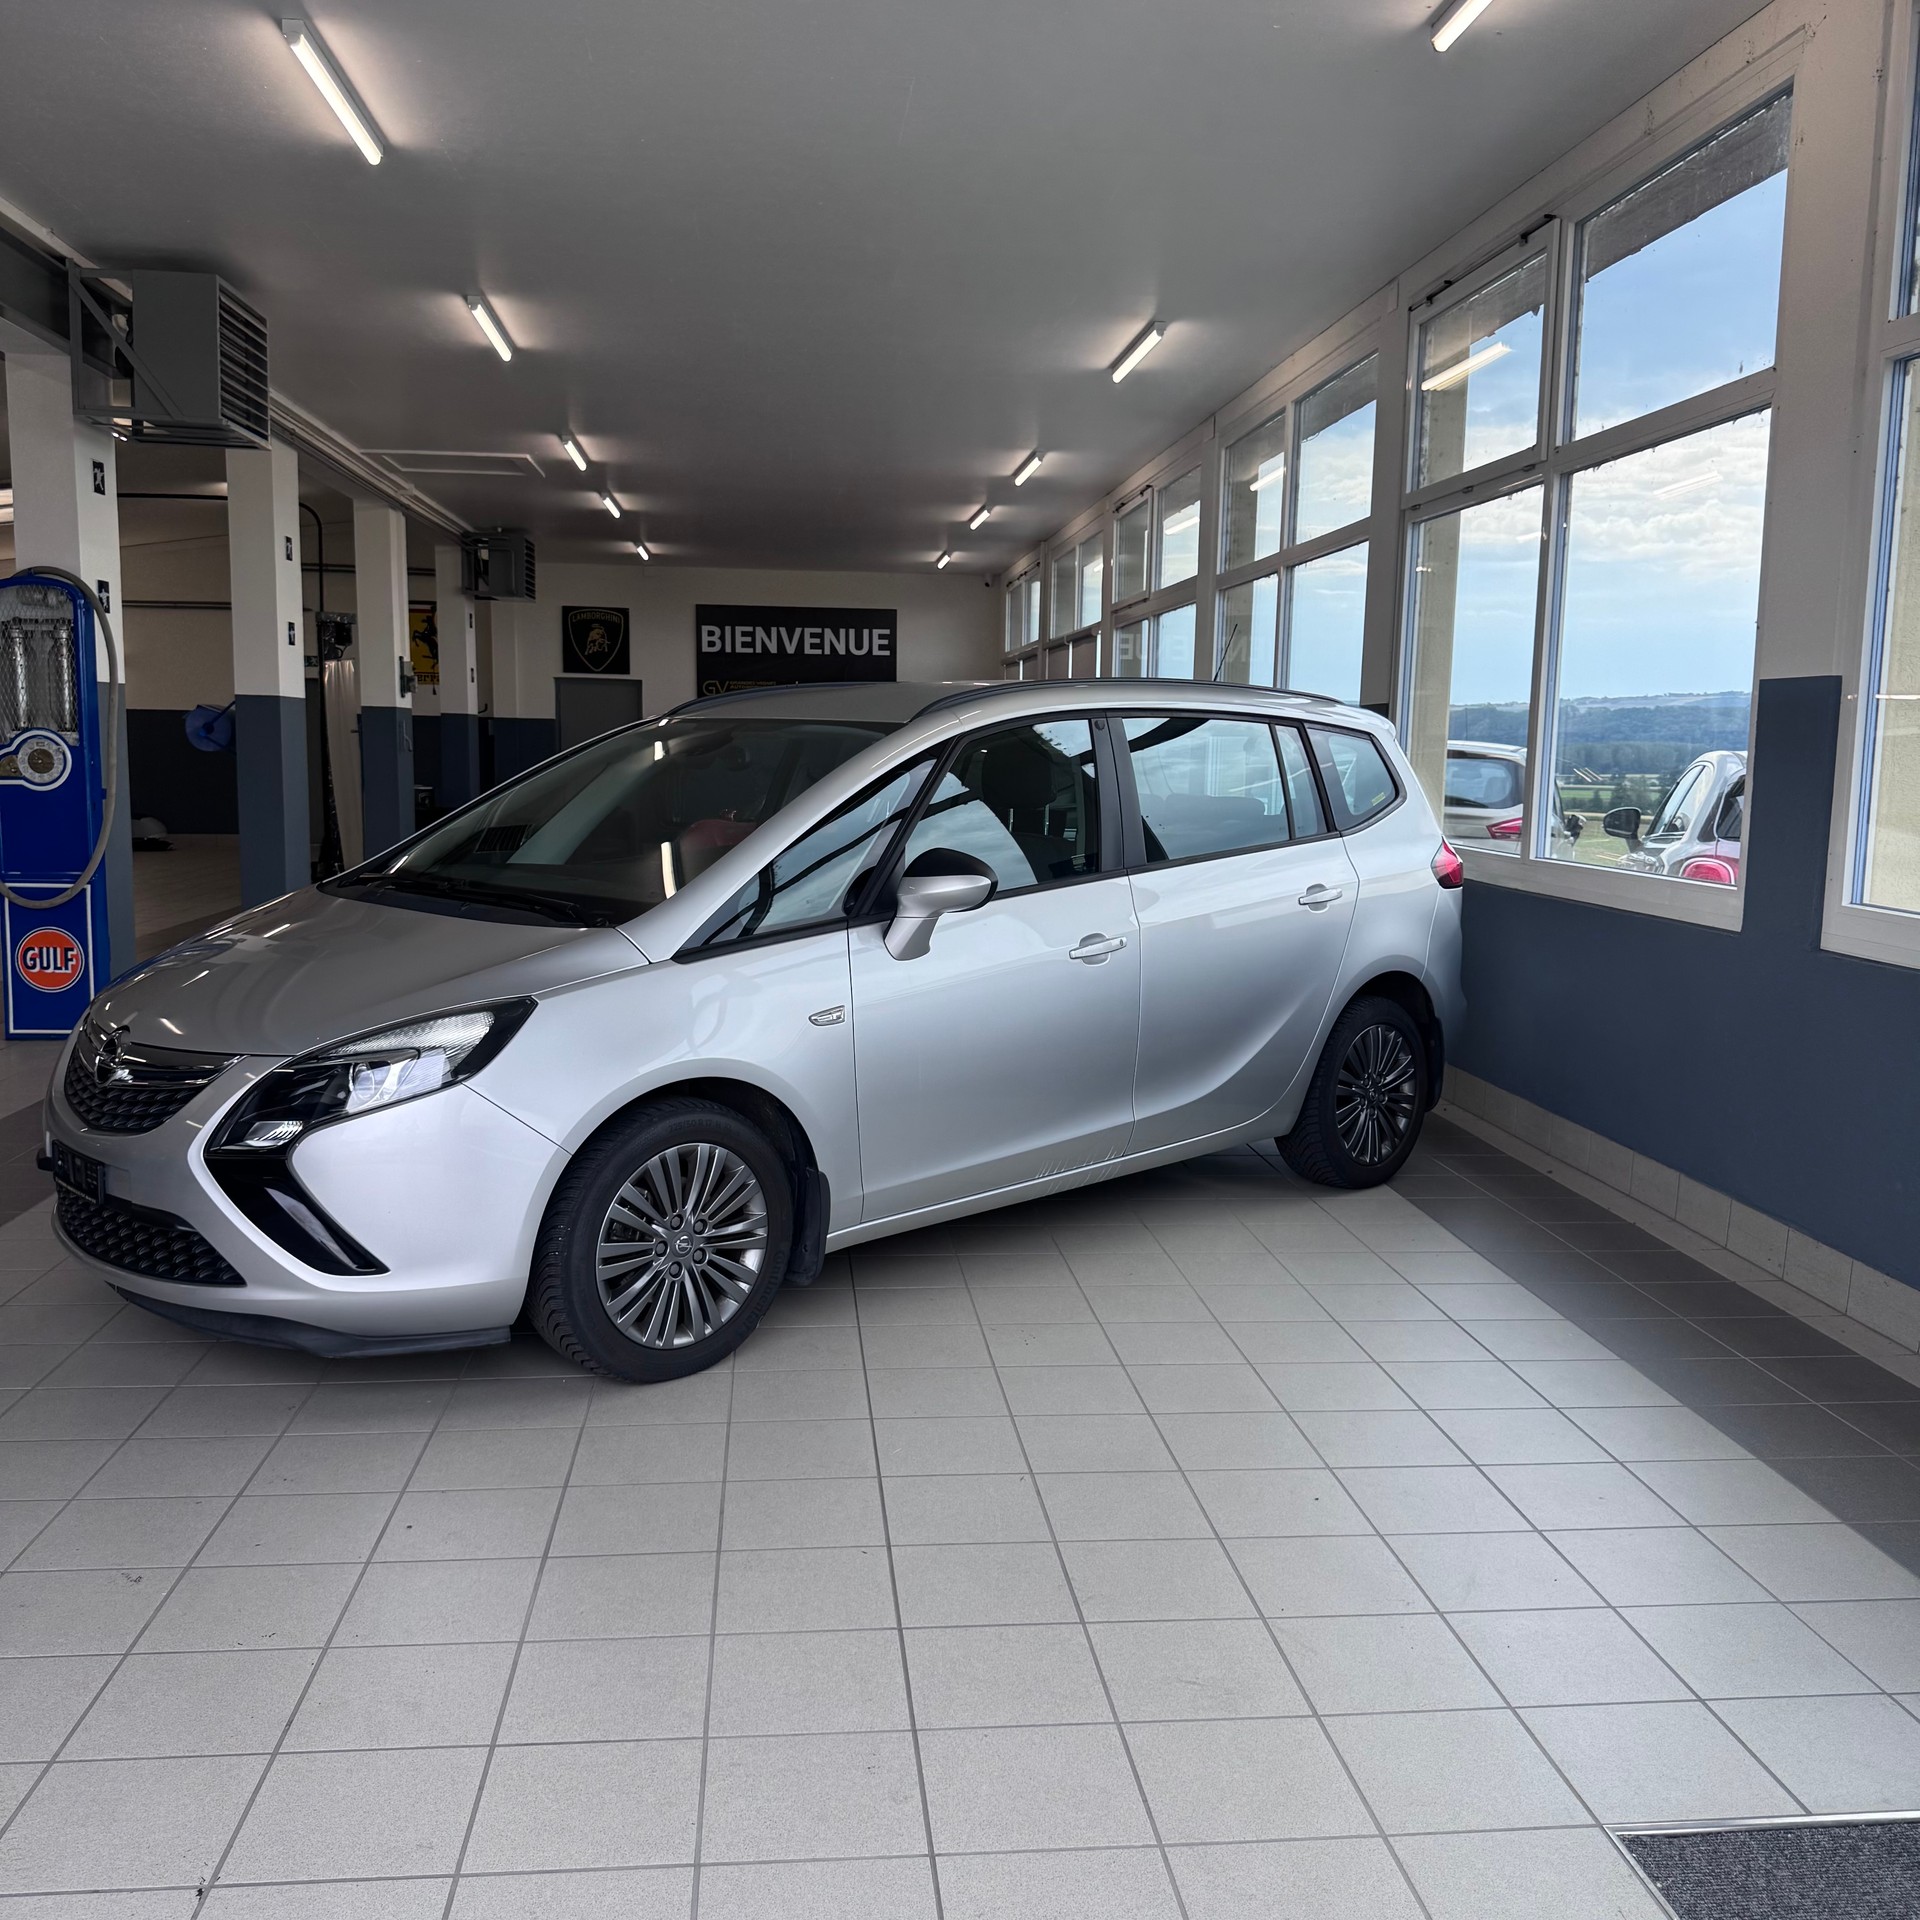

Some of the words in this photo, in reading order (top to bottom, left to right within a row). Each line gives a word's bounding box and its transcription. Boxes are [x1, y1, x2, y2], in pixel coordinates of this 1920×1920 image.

[571, 611, 621, 624] LAMBORGHINI
[701, 625, 890, 656] BIENVENUE
[22, 946, 77, 973] GULF
